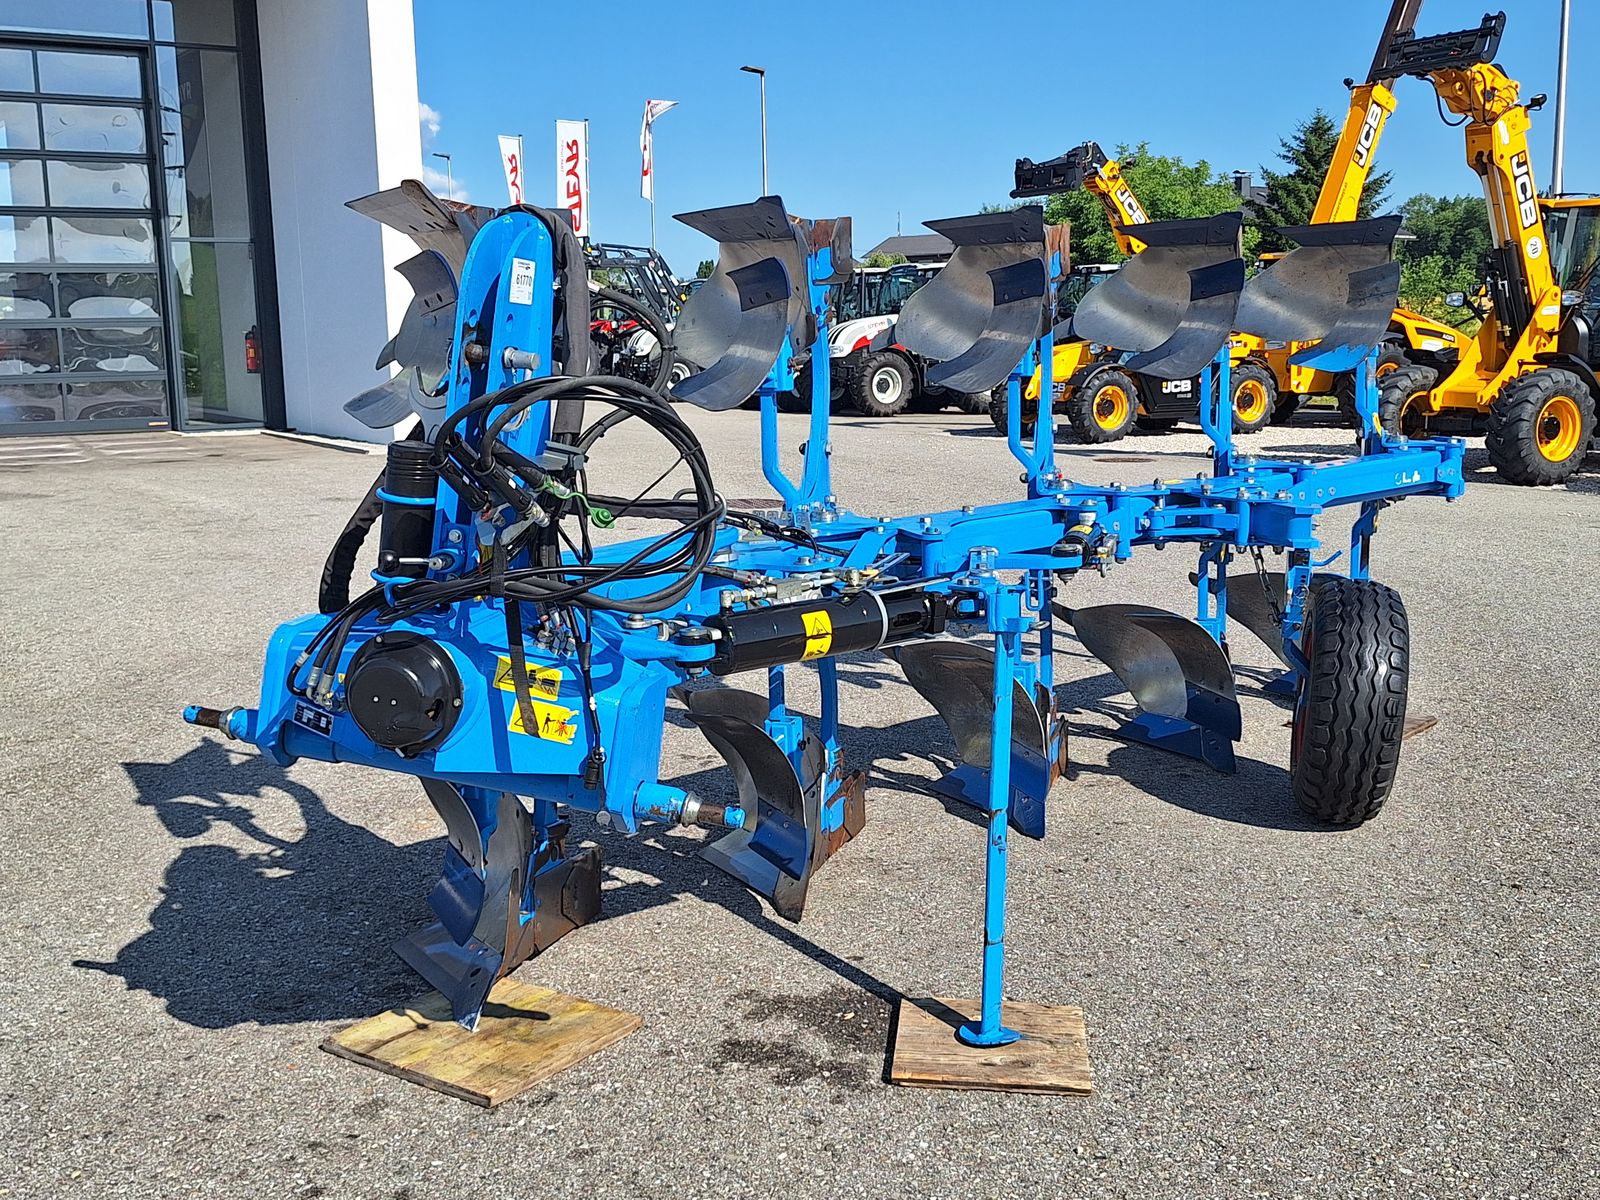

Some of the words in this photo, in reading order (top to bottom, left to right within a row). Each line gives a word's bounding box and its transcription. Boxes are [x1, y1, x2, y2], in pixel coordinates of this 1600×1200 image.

[1354, 103, 1382, 167] JCB
[1511, 151, 1537, 228] JCB
[1116, 184, 1147, 224] JCB
[1530, 240, 1539, 255] 20
[515, 274, 533, 287] 61770
[1051, 382, 1066, 392] CB
[1162, 380, 1192, 394] JCB
